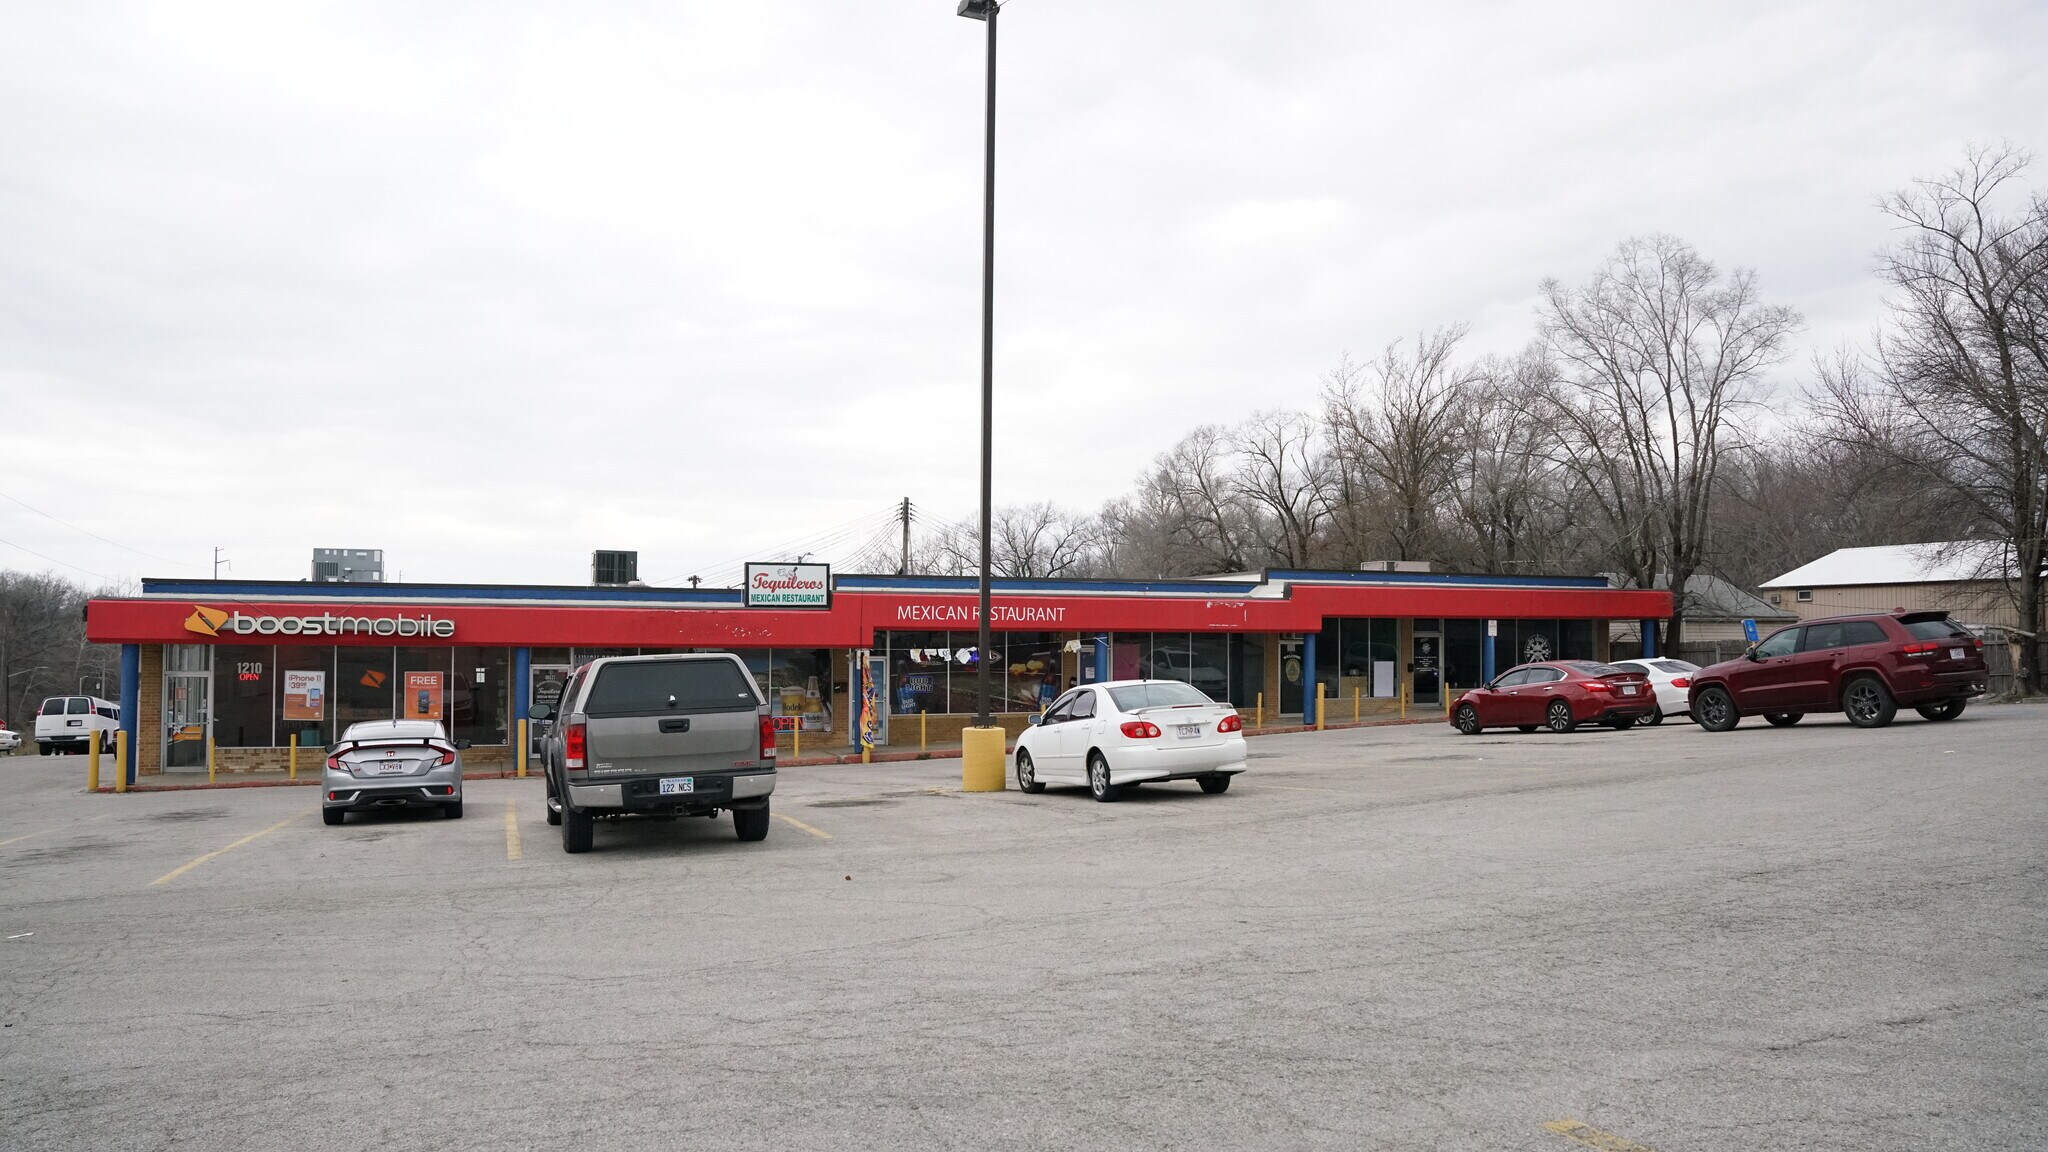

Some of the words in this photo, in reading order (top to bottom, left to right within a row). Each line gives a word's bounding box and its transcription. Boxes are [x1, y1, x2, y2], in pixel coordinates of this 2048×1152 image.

[752, 572, 823, 593] Tequileros
[751, 594, 780, 602] MEXICAN
[782, 594, 824, 602] RESTAURANT
[897, 606, 968, 620] MEXICAN
[973, 606, 1066, 621] RSTAURANT
[237, 662, 262, 674] 1210
[410, 676, 438, 685] FREE
[906, 684, 932, 692] LIGHT
[662, 783, 675, 793] 122
[678, 782, 692, 792] NCS
